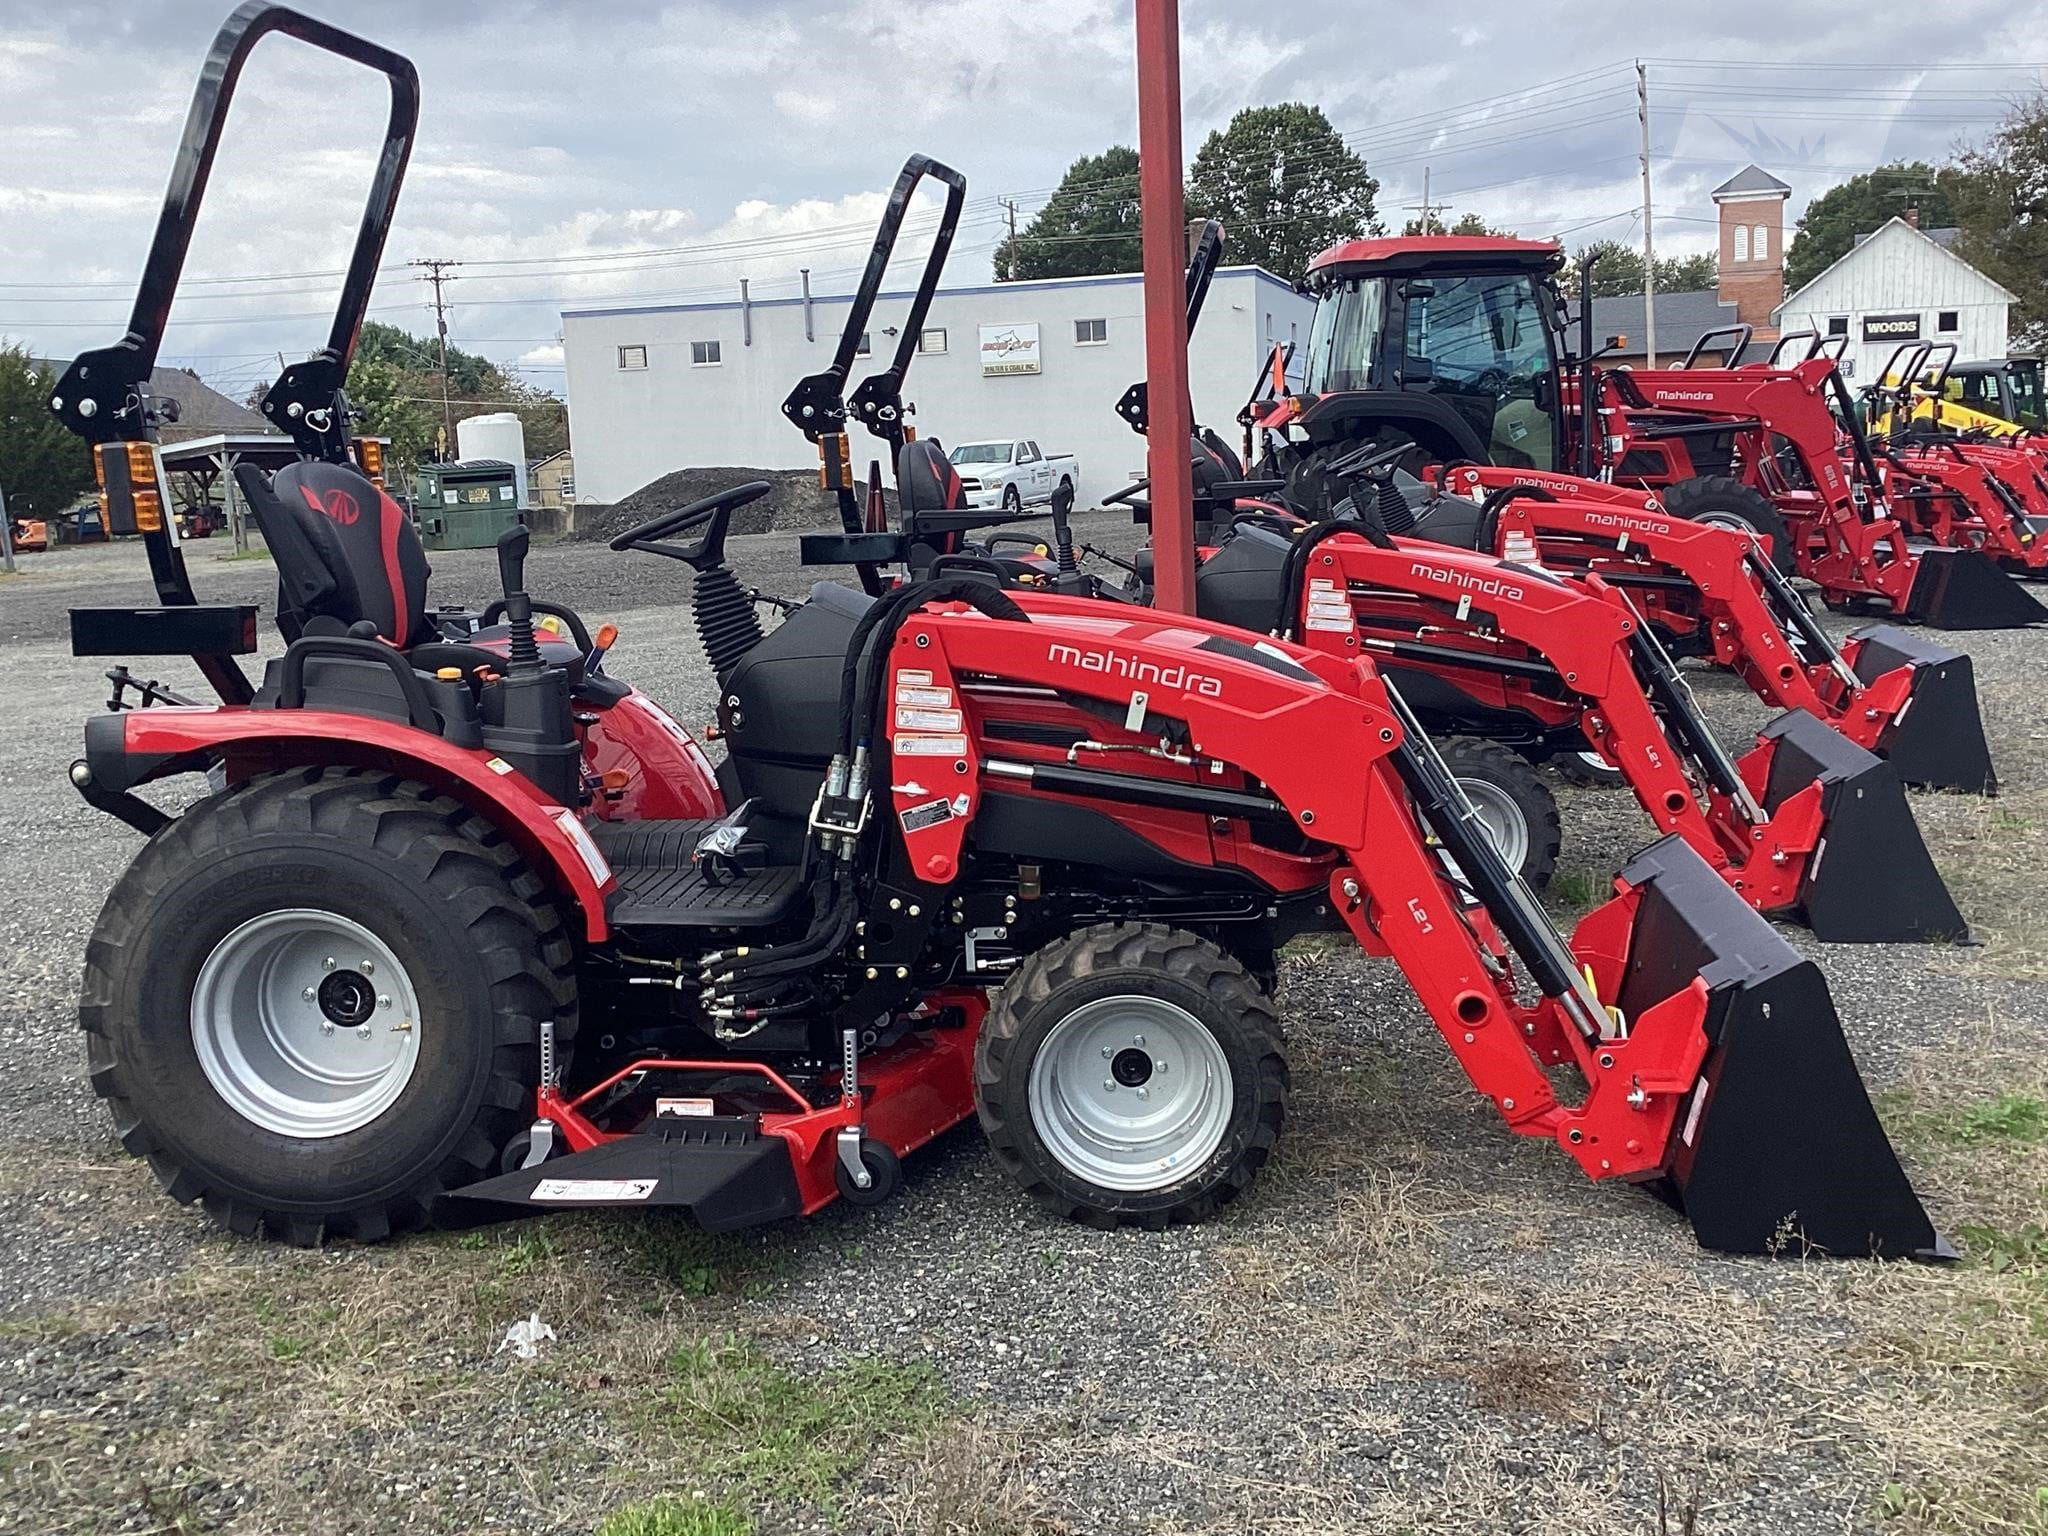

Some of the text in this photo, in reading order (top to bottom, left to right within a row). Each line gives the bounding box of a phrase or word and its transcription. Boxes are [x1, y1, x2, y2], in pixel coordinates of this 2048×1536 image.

[1866, 321, 1917, 334] WOODS
[1906, 462, 1949, 471] mahindra
[1513, 476, 1579, 493] mahindra
[1584, 513, 1670, 534] mahindra
[1410, 563, 1523, 601] mahindra
[1048, 644, 1222, 697] mahindra
[1645, 745, 1662, 768] L21
[1407, 897, 1433, 934] L21
